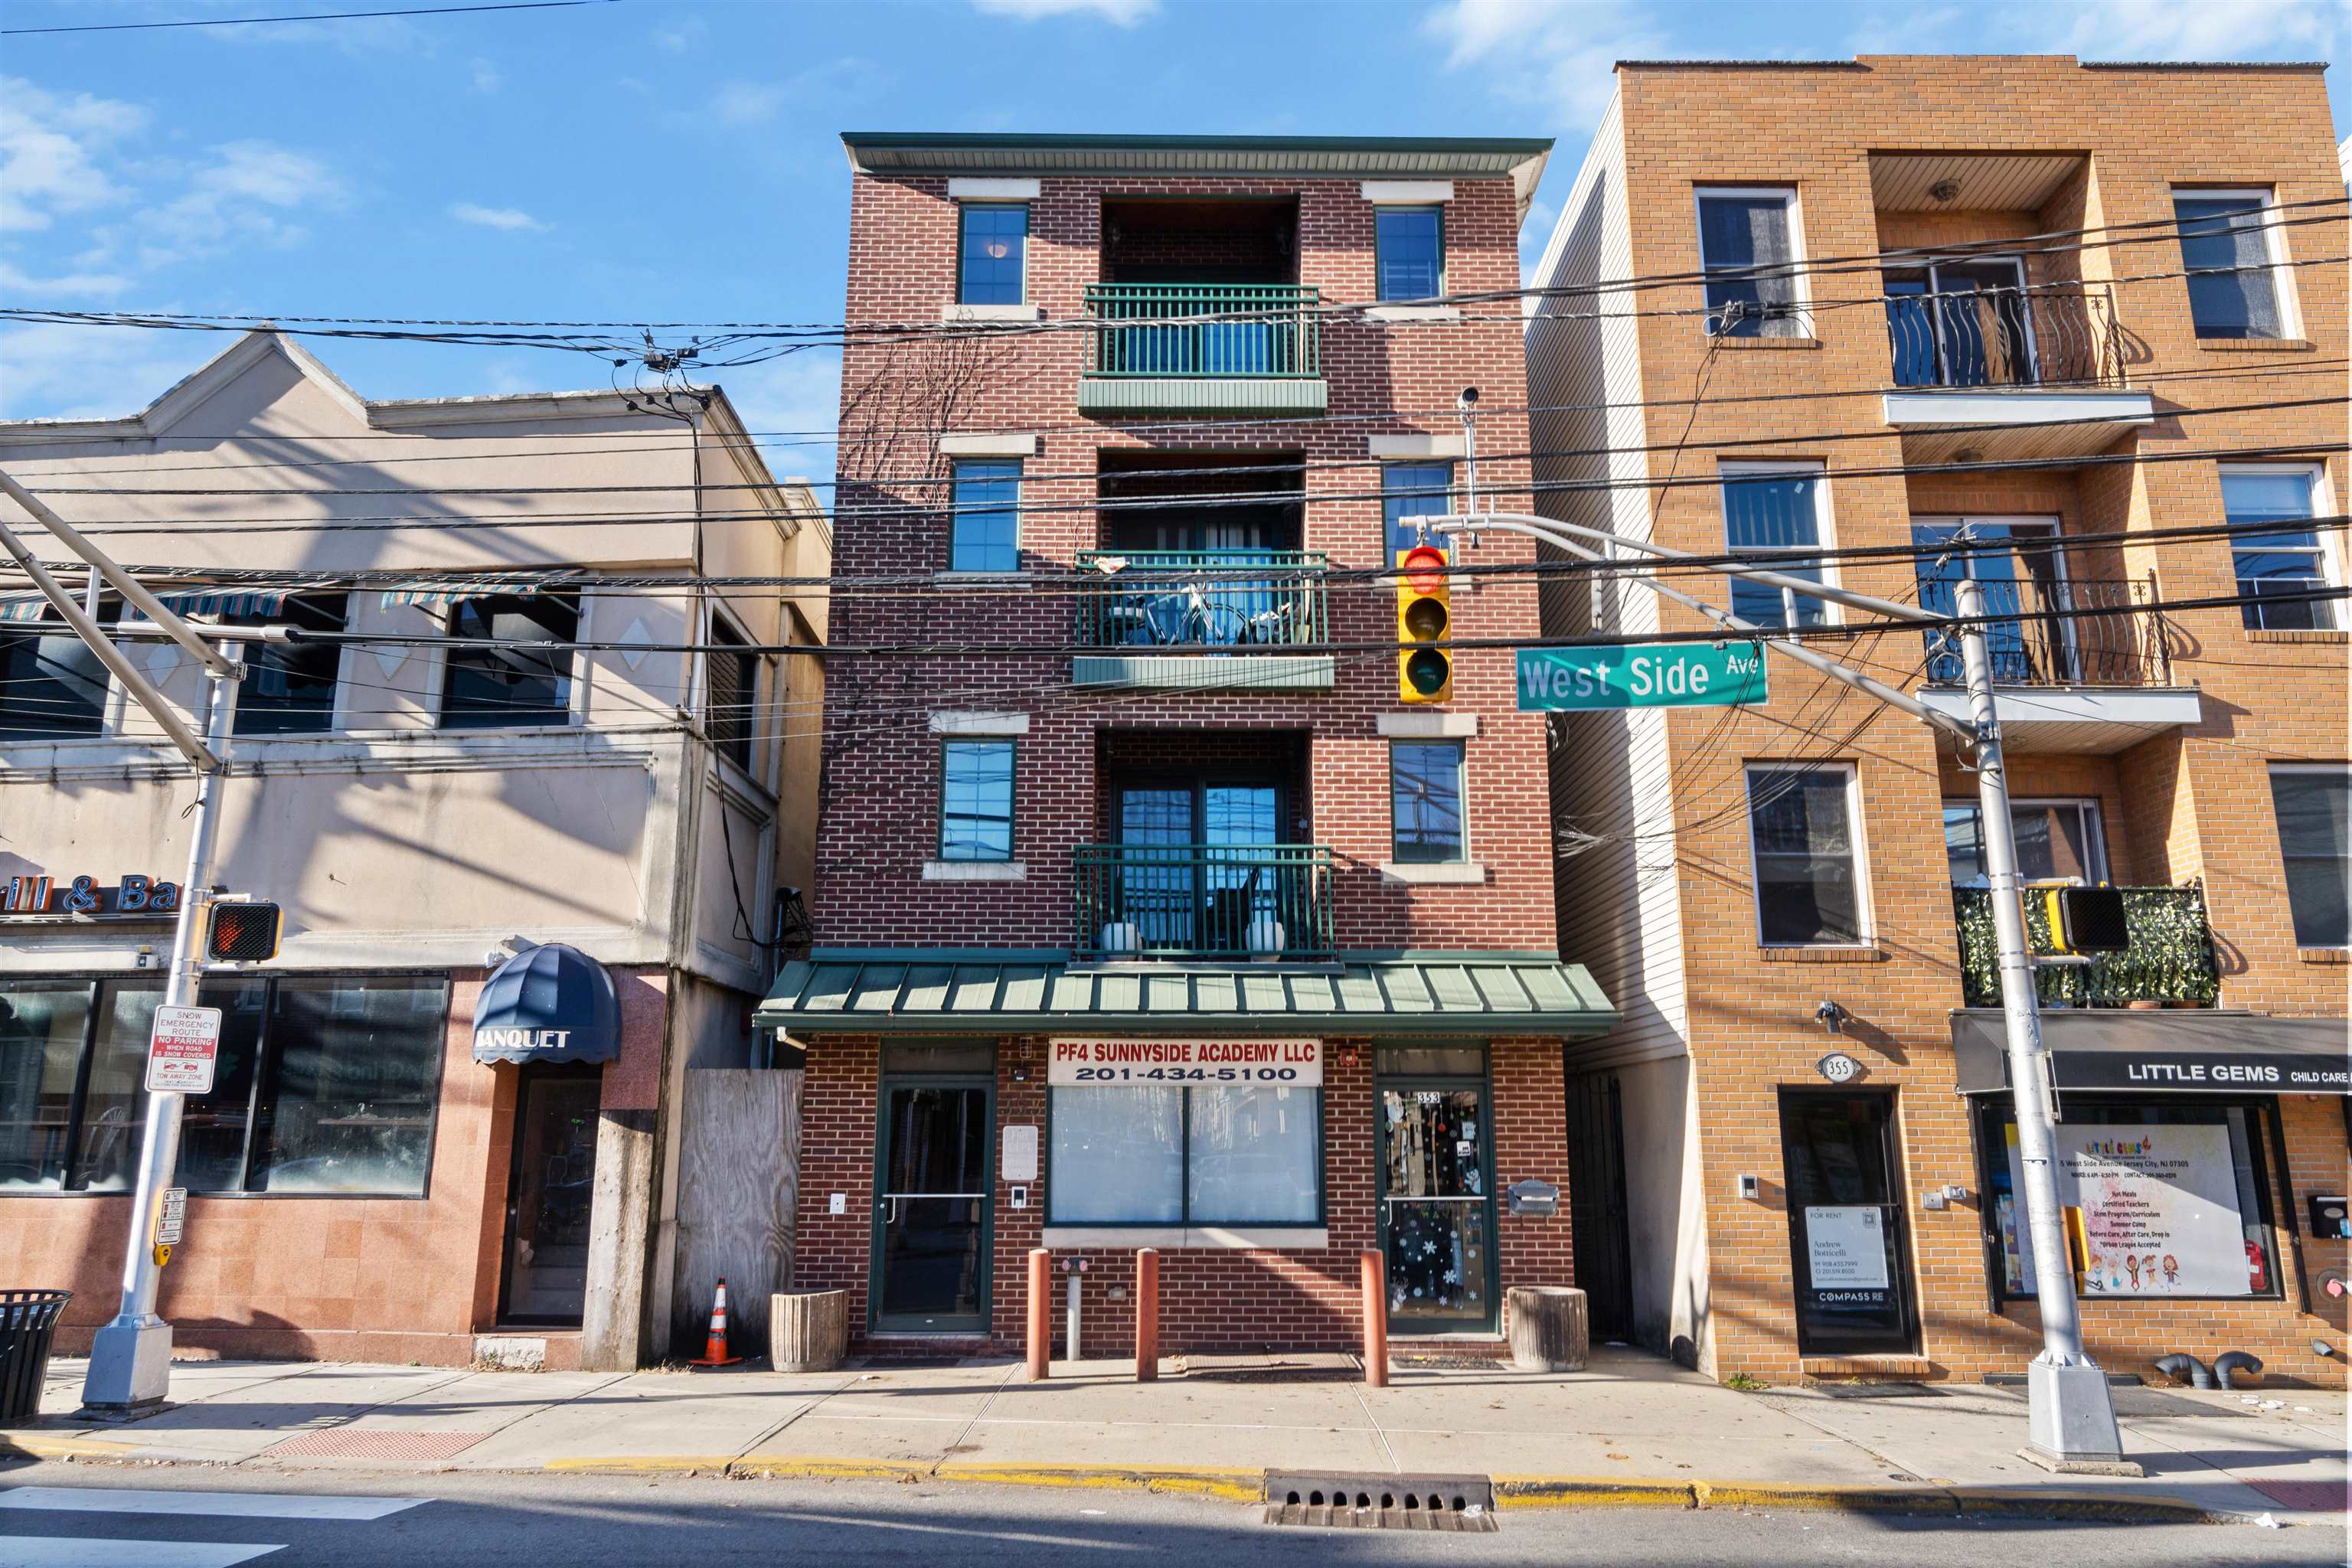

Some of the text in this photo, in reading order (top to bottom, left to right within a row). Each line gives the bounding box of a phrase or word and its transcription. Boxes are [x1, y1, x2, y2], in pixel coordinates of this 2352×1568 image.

[1523, 655, 1759, 698] West Side Ave
[64, 875, 103, 911] &
[160, 1019, 214, 1029] EMERGENCY
[172, 1028, 201, 1037] ROUTE
[174, 1037, 212, 1046] PARKING
[475, 1030, 571, 1048] BANQUET
[1056, 1043, 1315, 1063] PF4 SUNNYSIDE ACADEMY LLC
[1828, 1060, 1848, 1075] 355
[2128, 1064, 2348, 1083] LITTLE GEMS CHILD CARE
[1076, 1068, 1297, 1080] 201-434-5100
[1418, 1093, 1439, 1103] 353
[2145, 1160, 2159, 1168] City,
[1819, 1292, 1883, 1302] COMPASS RE
